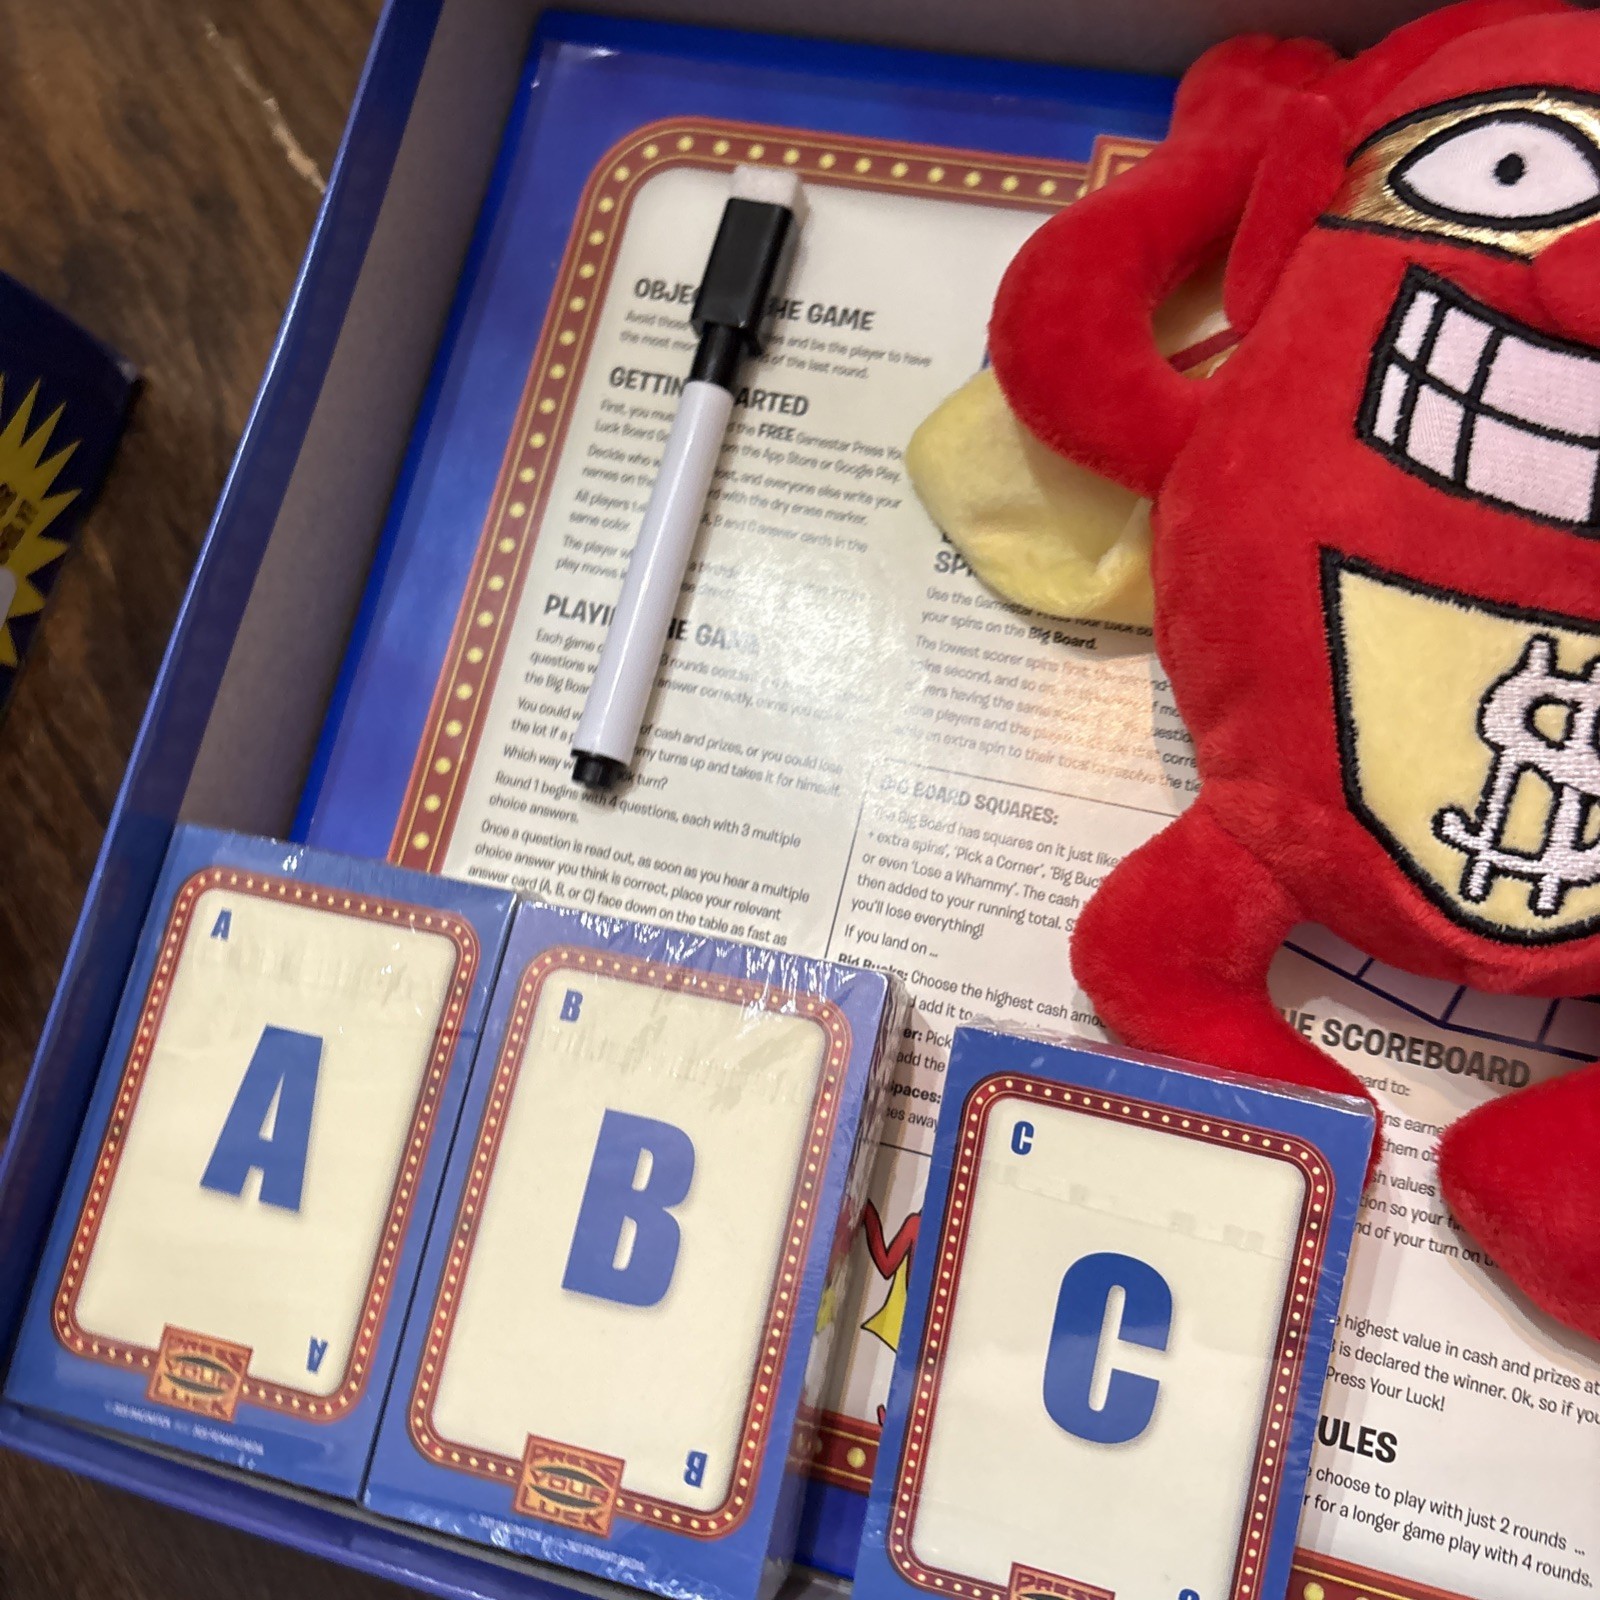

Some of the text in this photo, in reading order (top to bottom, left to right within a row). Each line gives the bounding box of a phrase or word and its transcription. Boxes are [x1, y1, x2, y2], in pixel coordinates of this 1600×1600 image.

[635, 278, 693, 305] OBJE
[807, 303, 875, 331] GAME
[609, 366, 687, 398] GETTIN
[733, 385, 809, 416] ARTED
[758, 423, 795, 442] FREE
[544, 594, 616, 628] PLAYI
[495, 770, 801, 848] Round 1 begins with 4 questions, each with 3 multiple
[912, 781, 1059, 825] BOARD SQUARES:
[919, 813, 957, 834] Board
[958, 824, 980, 840] has
[983, 831, 1033, 851] squares
[1036, 842, 1053, 854] on
[1055, 843, 1066, 857] it
[1066, 846, 1093, 863] just
[1096, 852, 1116, 867] like
[481, 819, 810, 903] Once a question is read out, as soon as you hear a multiple
[877, 832, 910, 848] extra
[985, 855, 993, 866] a
[1075, 871, 1099, 888] Buc
[862, 853, 876, 864] or
[878, 857, 908, 871] even
[944, 871, 953, 881] a
[1024, 884, 1046, 901] The
[1048, 893, 1080, 909] cash
[468, 866, 509, 883] answer
[511, 875, 538, 892] card
[568, 888, 581, 899] or
[583, 888, 595, 904] C)
[597, 891, 626, 909] face
[626, 899, 657, 916] down
[659, 908, 674, 920] on
[676, 910, 696, 925] the
[699, 916, 728, 933] table
[730, 925, 744, 937] as
[747, 925, 770, 942] fast
[772, 934, 787, 946] as
[851, 898, 985, 938] you'll lose everything!
[857, 874, 1061, 929] then added to your running total.
[211, 909, 231, 939] A
[844, 924, 927, 955] If you land on
[559, 988, 584, 1022] B
[911, 968, 1068, 1019] Choose the highest cash
[919, 1000, 973, 1020] add it to
[925, 1030, 952, 1049] Pick
[1321, 1018, 1530, 1089] SCOREBOARD
[896, 1048, 945, 1072] add the
[887, 1081, 941, 1104] paces:
[1391, 1081, 1410, 1096] to:
[200, 1023, 323, 1214] A
[1011, 1120, 1035, 1156] C
[1391, 1177, 1437, 1197] values
[561, 1108, 696, 1308] B
[1390, 1204, 1443, 1225] so your
[1374, 1226, 1480, 1263] of your turn on
[306, 1336, 328, 1374] A
[1043, 1252, 1172, 1444] C
[1345, 1315, 1600, 1396] highest value in cash and prizes at
[1326, 1366, 1445, 1411] Press Your Luck!
[1339, 1341, 1351, 1357] is
[1355, 1347, 1420, 1376] declared
[1424, 1365, 1449, 1383] the
[1453, 1374, 1506, 1399] winner.
[1512, 1387, 1534, 1408] Ok,
[1539, 1398, 1557, 1413] so
[1561, 1400, 1574, 1416] if
[1317, 1415, 1398, 1464] ULES
[530, 1468, 611, 1502] YOUR
[684, 1450, 708, 1488] B
[1316, 1468, 1566, 1550] choose to play with just 2 rounds
[1315, 1494, 1592, 1587] for a longer game play with 4 rounds.
